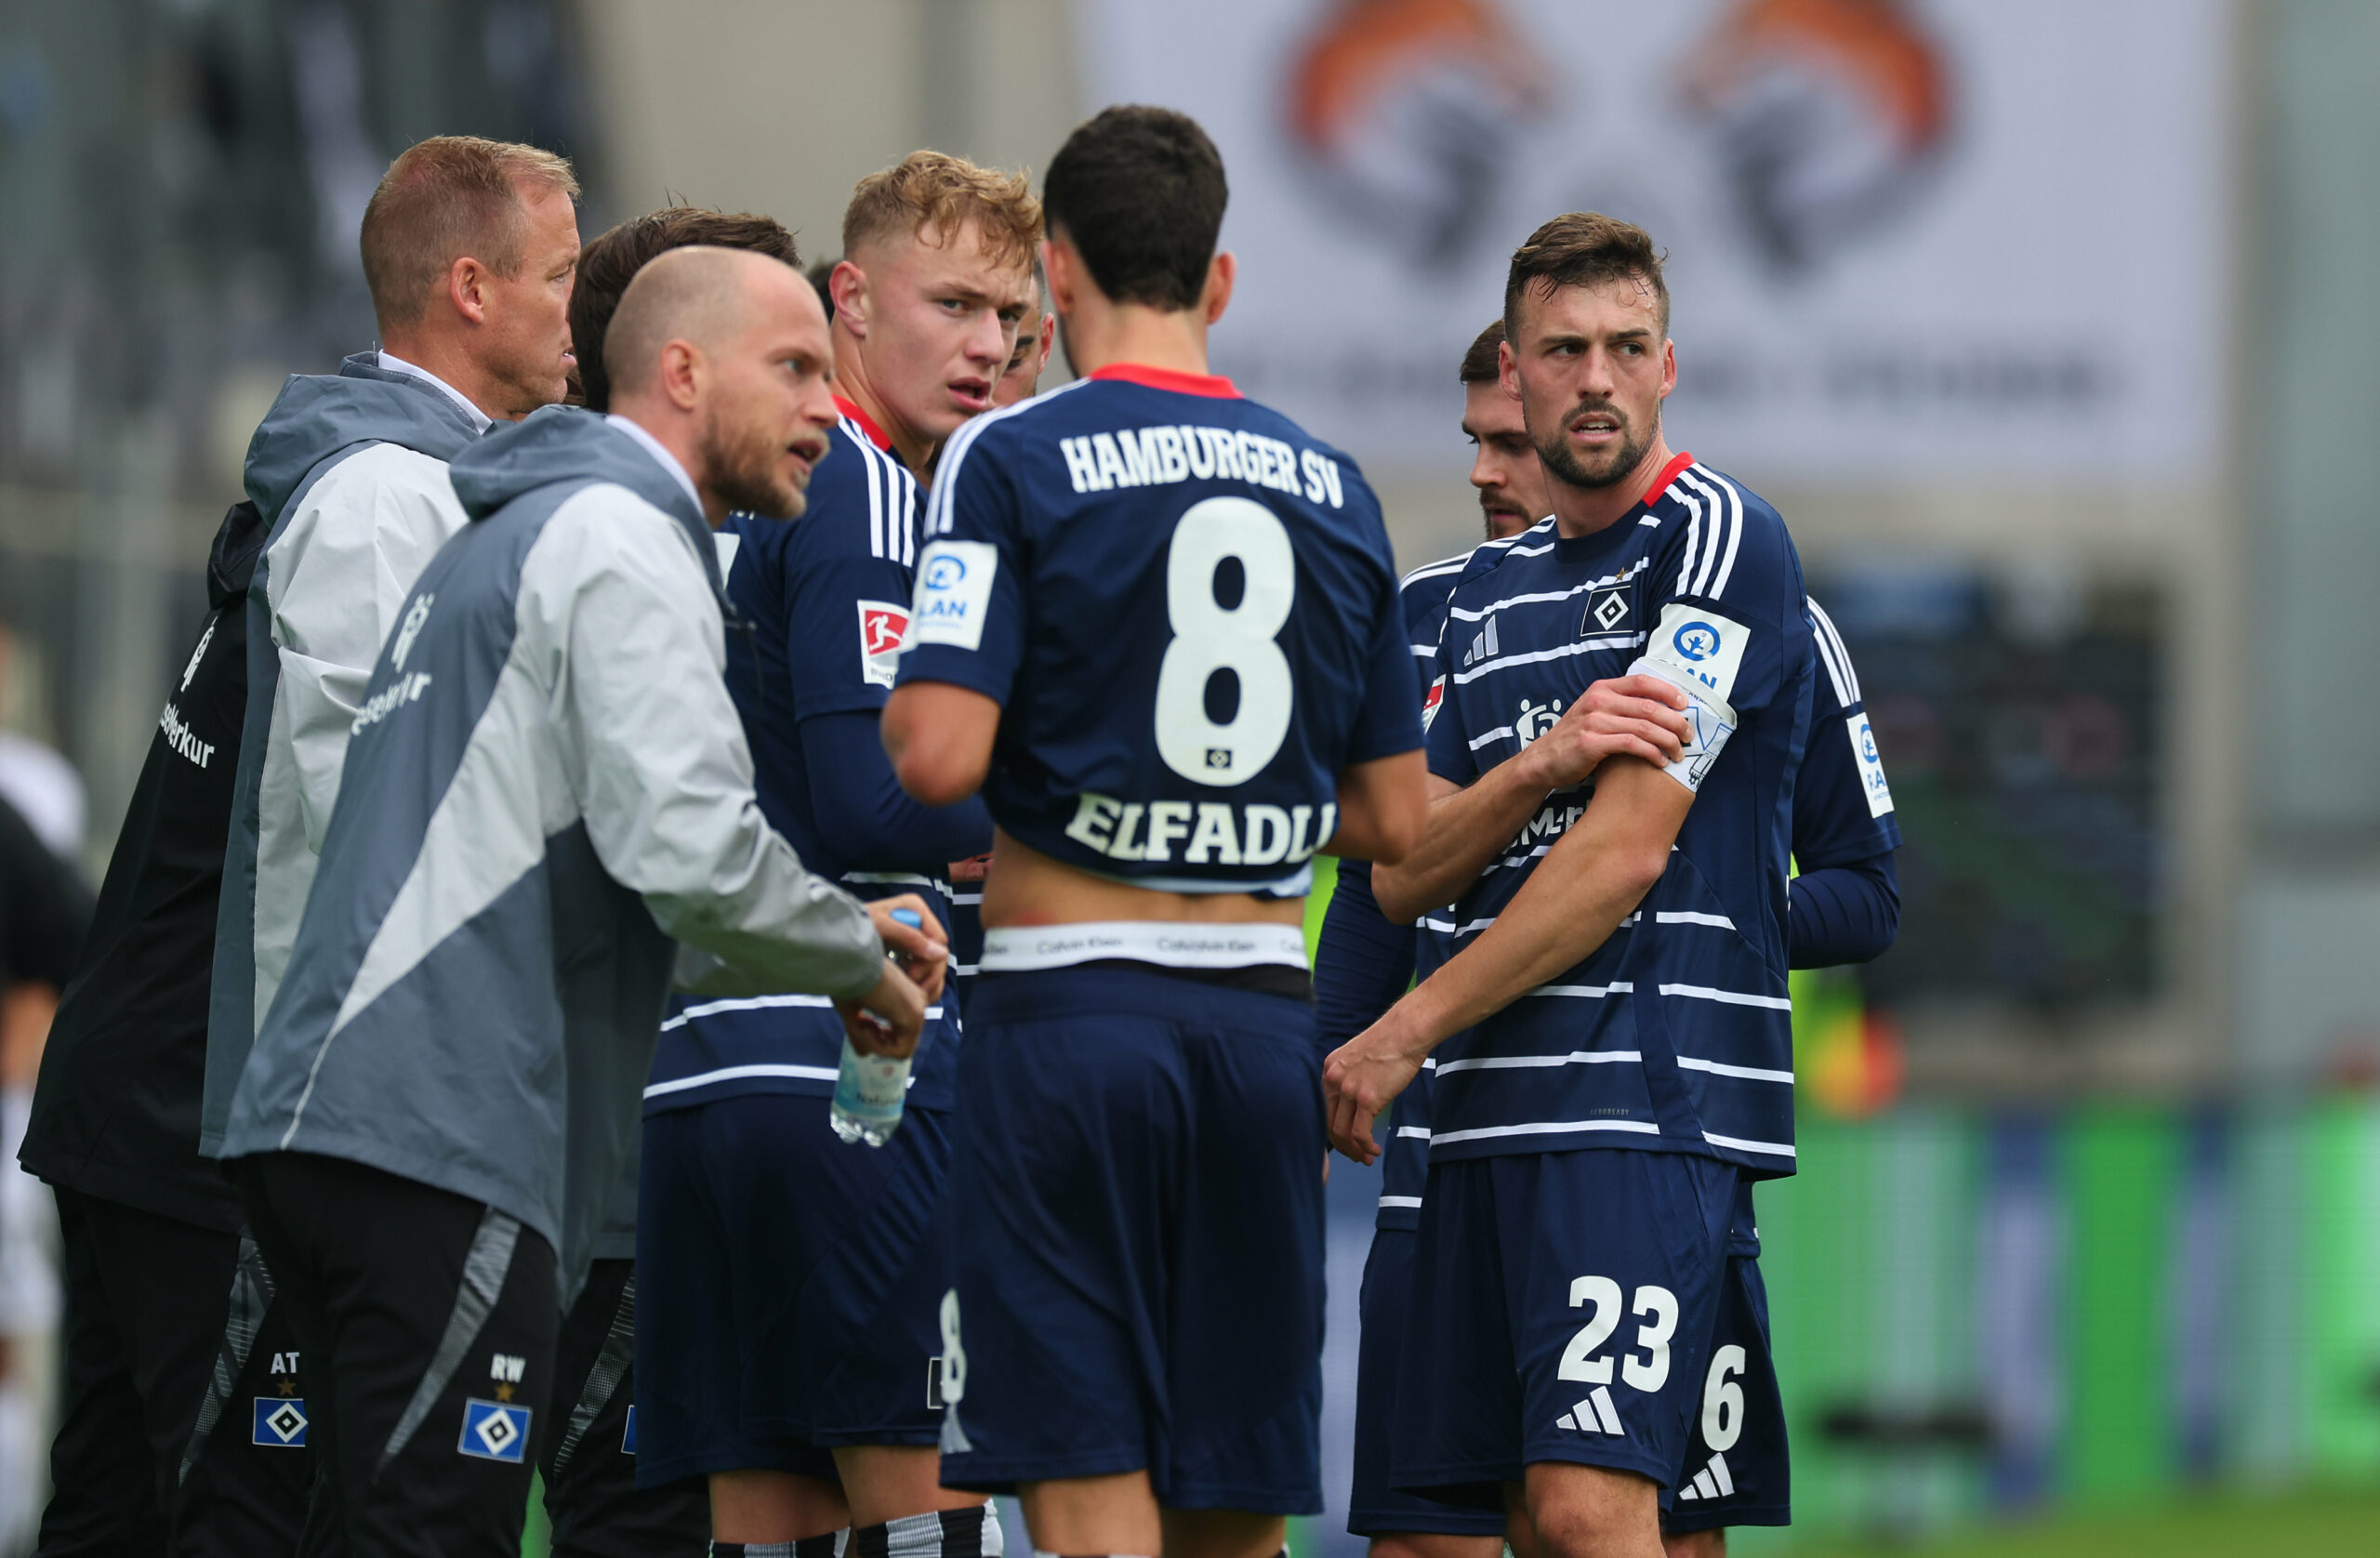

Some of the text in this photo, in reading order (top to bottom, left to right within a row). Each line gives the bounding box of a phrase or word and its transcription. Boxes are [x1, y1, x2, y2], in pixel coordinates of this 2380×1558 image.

[1060, 425, 1343, 508] HAMBURGER SV
[918, 600, 967, 619] LAN
[1155, 495, 1295, 786] 8
[270, 1352, 299, 1374] AT
[490, 1353, 526, 1383] RW
[1557, 1275, 1679, 1393] 23
[1701, 1344, 1746, 1452] 6
